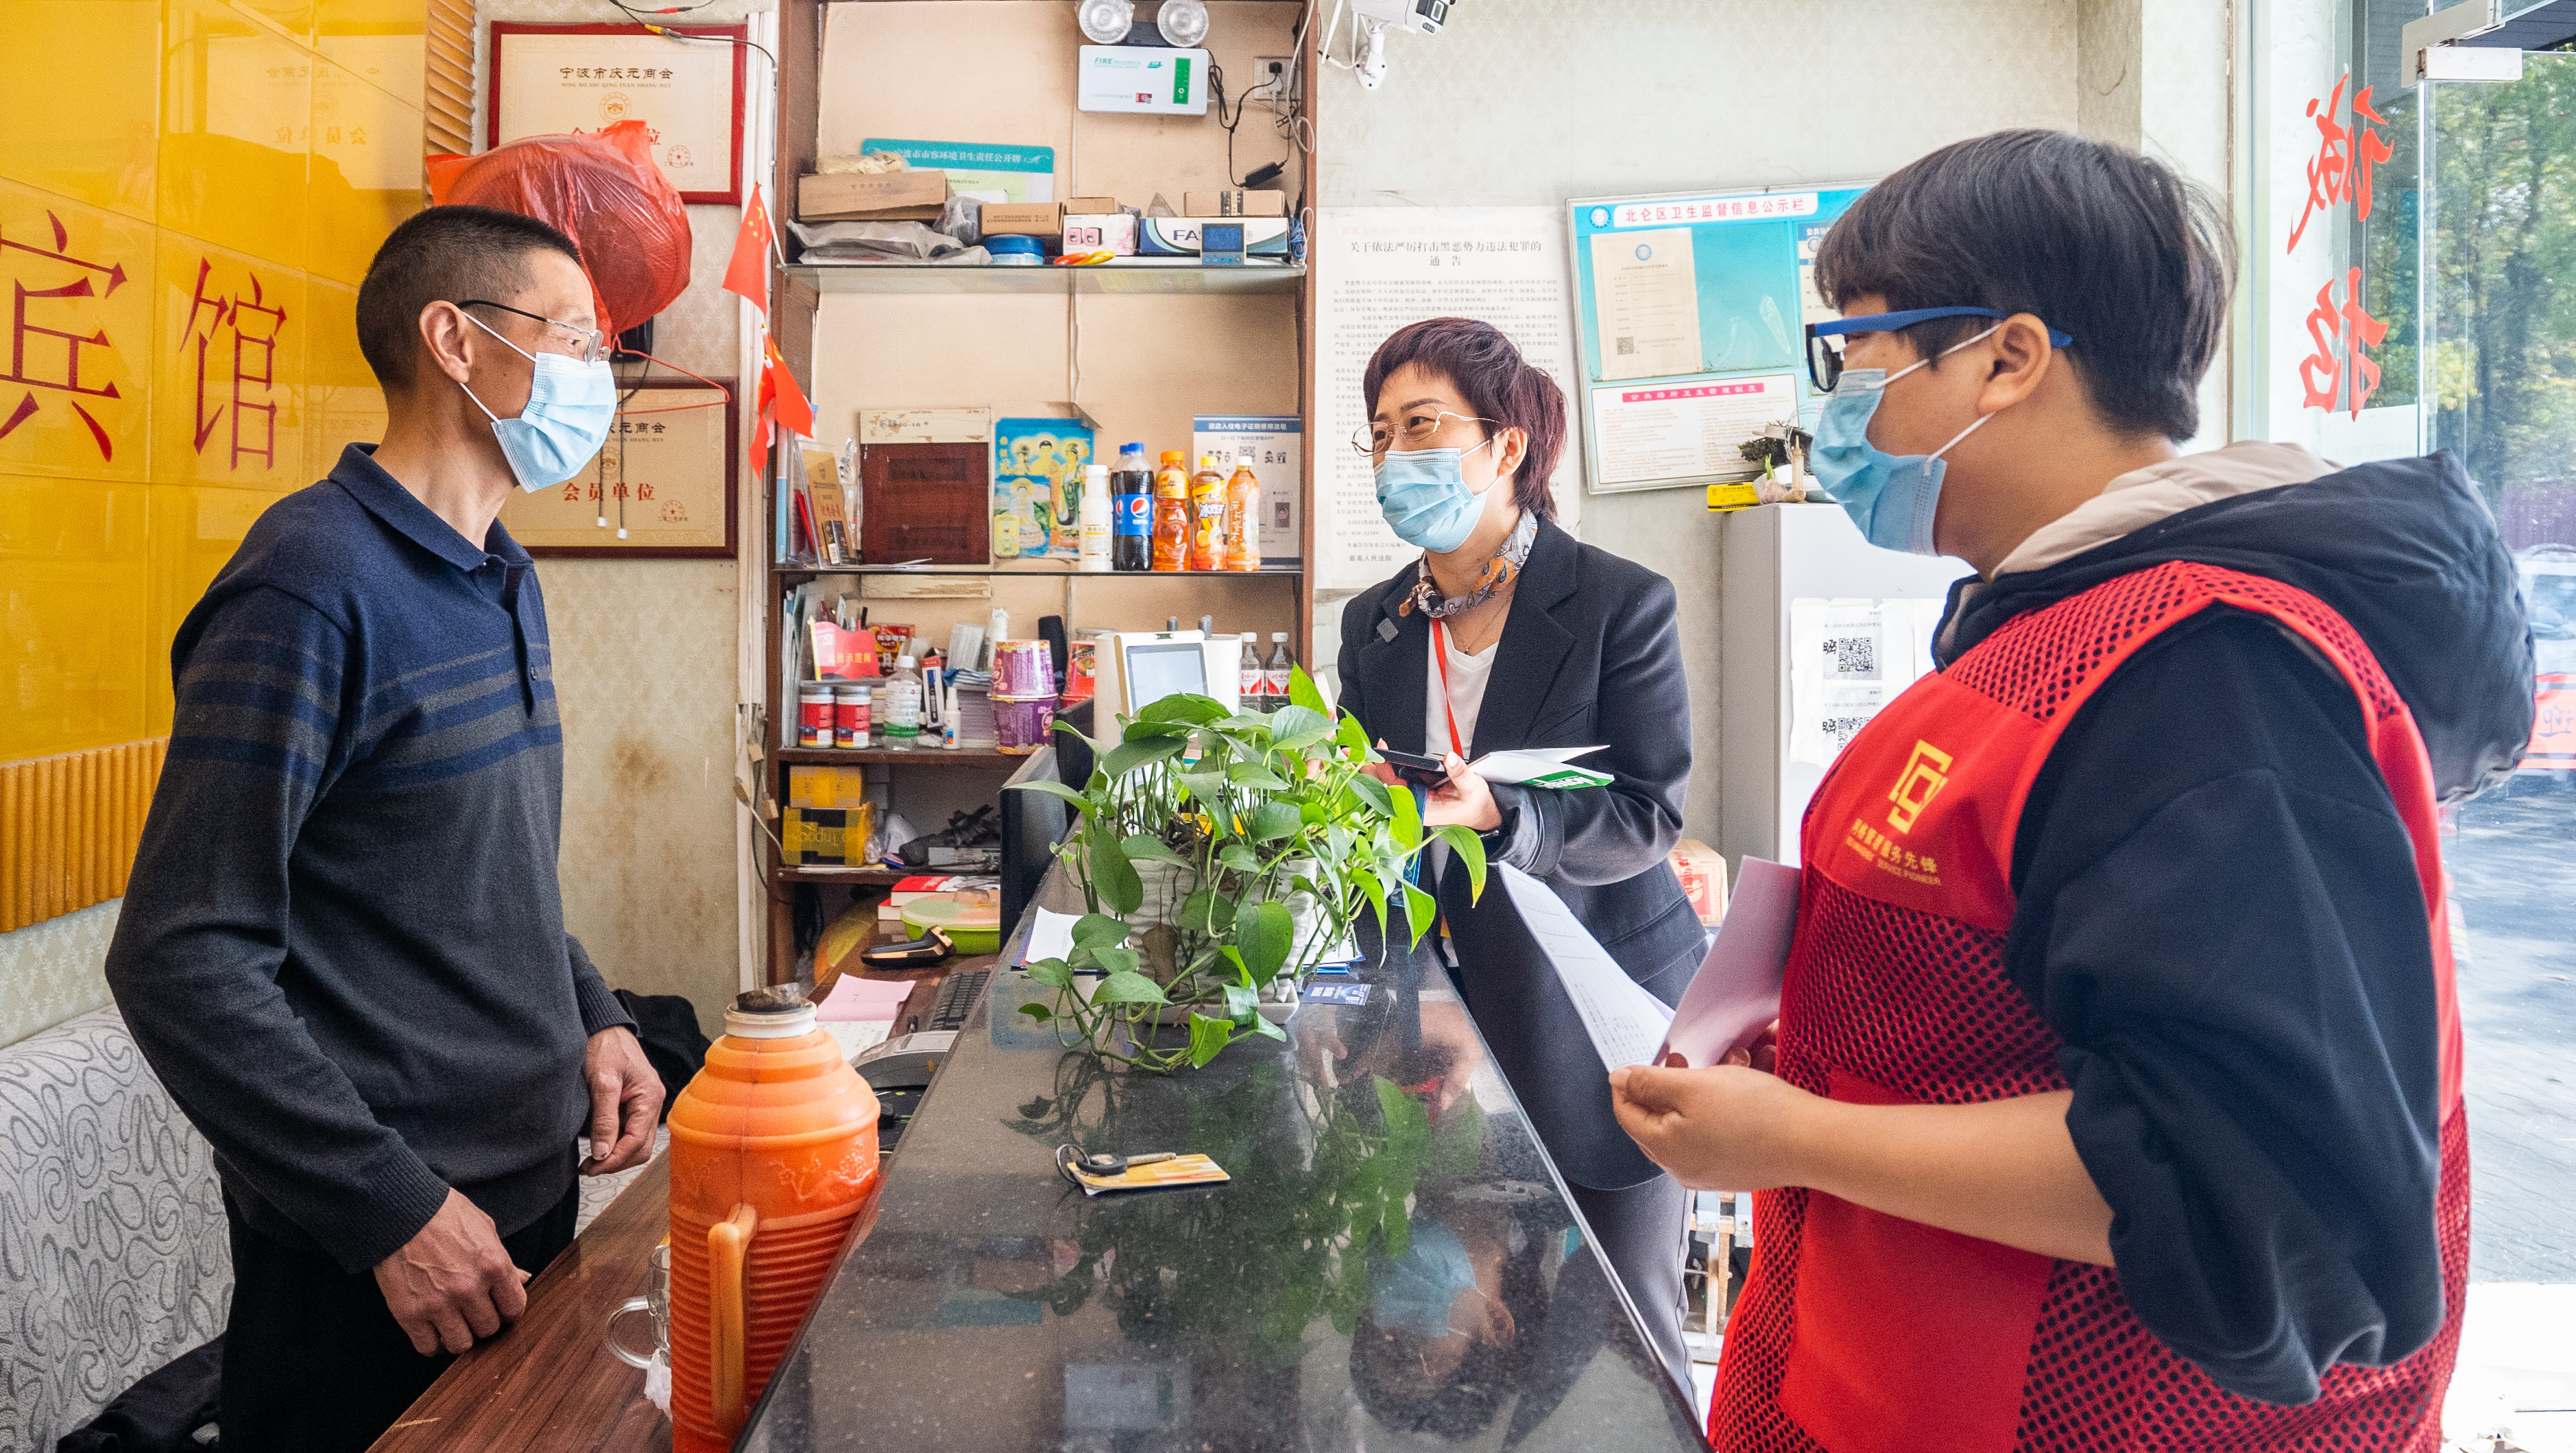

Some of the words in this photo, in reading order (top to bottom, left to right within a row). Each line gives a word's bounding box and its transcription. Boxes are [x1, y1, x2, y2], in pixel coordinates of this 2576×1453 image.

[559, 67, 674, 80] 宁波市庆元商会
[1626, 197, 1805, 223] 北仑区卫生监督信息公示栏
[1341, 226, 1399, 235] 最高人民法院
[1349, 240, 1542, 253] 关于依法严厉打击黑恶势力违法犯罪的
[0, 209, 287, 472] 宾馆
[1630, 385, 1757, 400] 公共场所卫生管理制度
[562, 482, 655, 502] 会员单位
